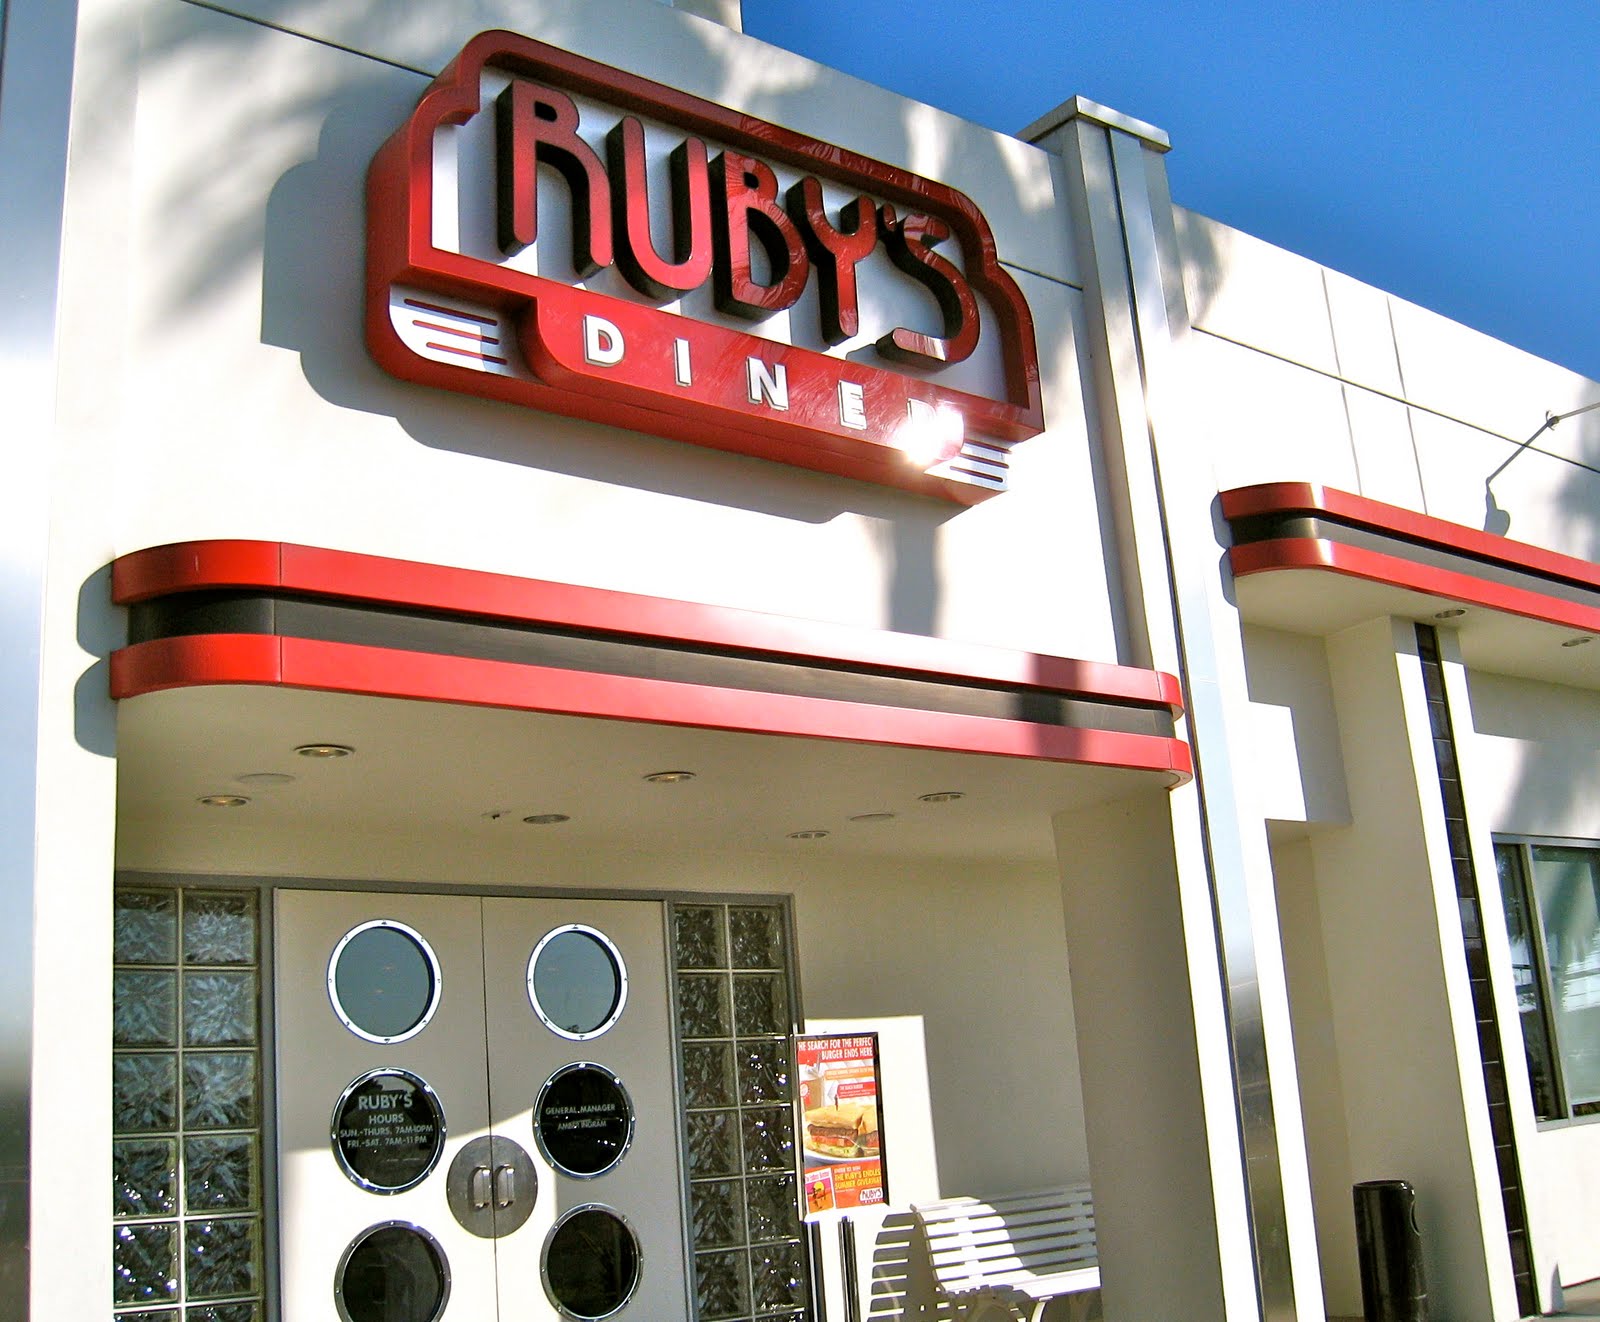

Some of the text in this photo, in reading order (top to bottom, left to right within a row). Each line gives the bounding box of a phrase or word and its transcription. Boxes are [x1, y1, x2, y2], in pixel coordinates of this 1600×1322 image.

[496, 79, 981, 365] RUBY'S
[807, 1040, 829, 1050] SEARCH
[830, 1039, 841, 1049] FOR
[842, 1038, 852, 1048] THE
[821, 1047, 873, 1060] BURGER ENDS HERE
[358, 1093, 413, 1111] RUBY'S
[545, 1104, 615, 1115] GENERAL MANAGER
[368, 1113, 404, 1125] HOURS
